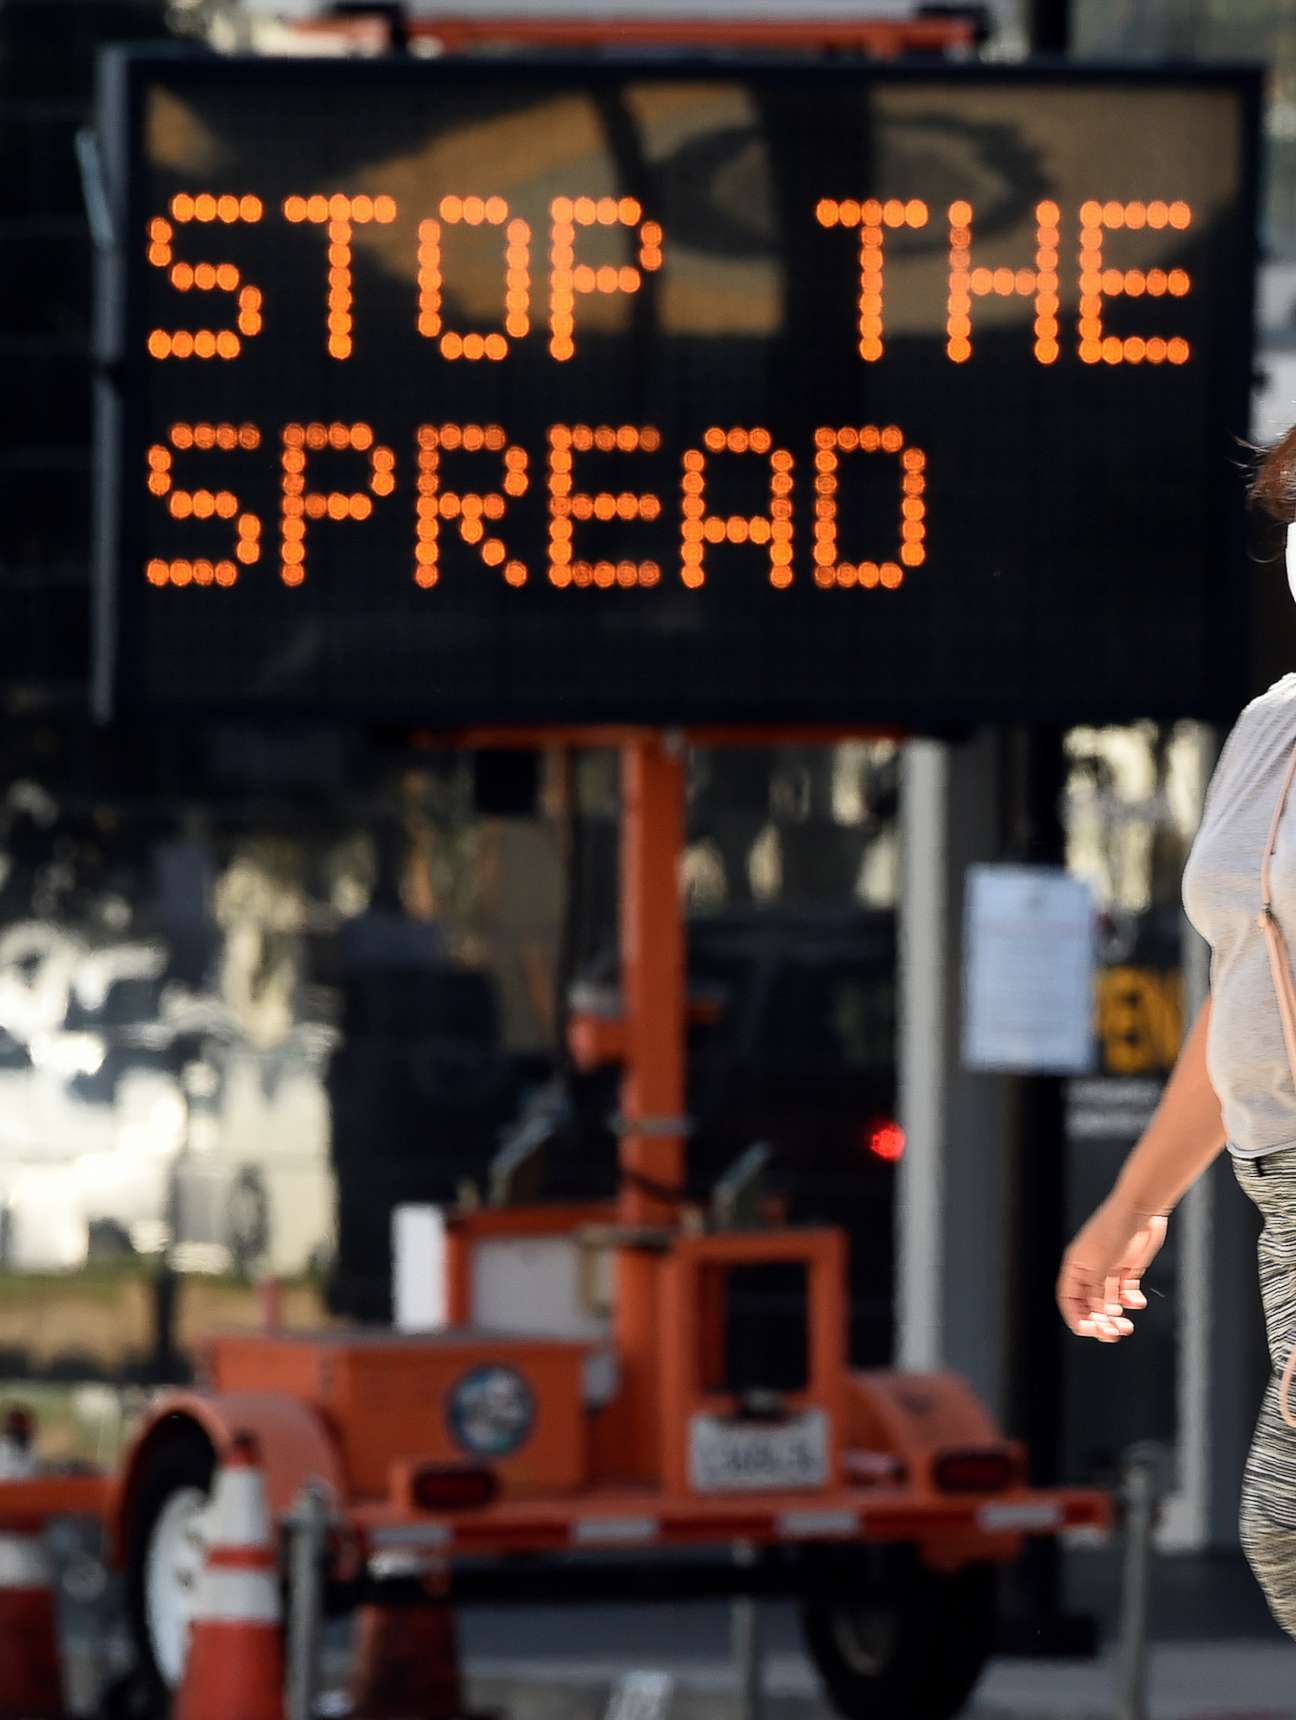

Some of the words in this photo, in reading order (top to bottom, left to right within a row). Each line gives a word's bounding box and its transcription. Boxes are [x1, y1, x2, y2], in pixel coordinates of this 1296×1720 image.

[147, 193, 664, 361] STOP
[815, 199, 1192, 366] THE
[146, 423, 926, 588] SPREAD
